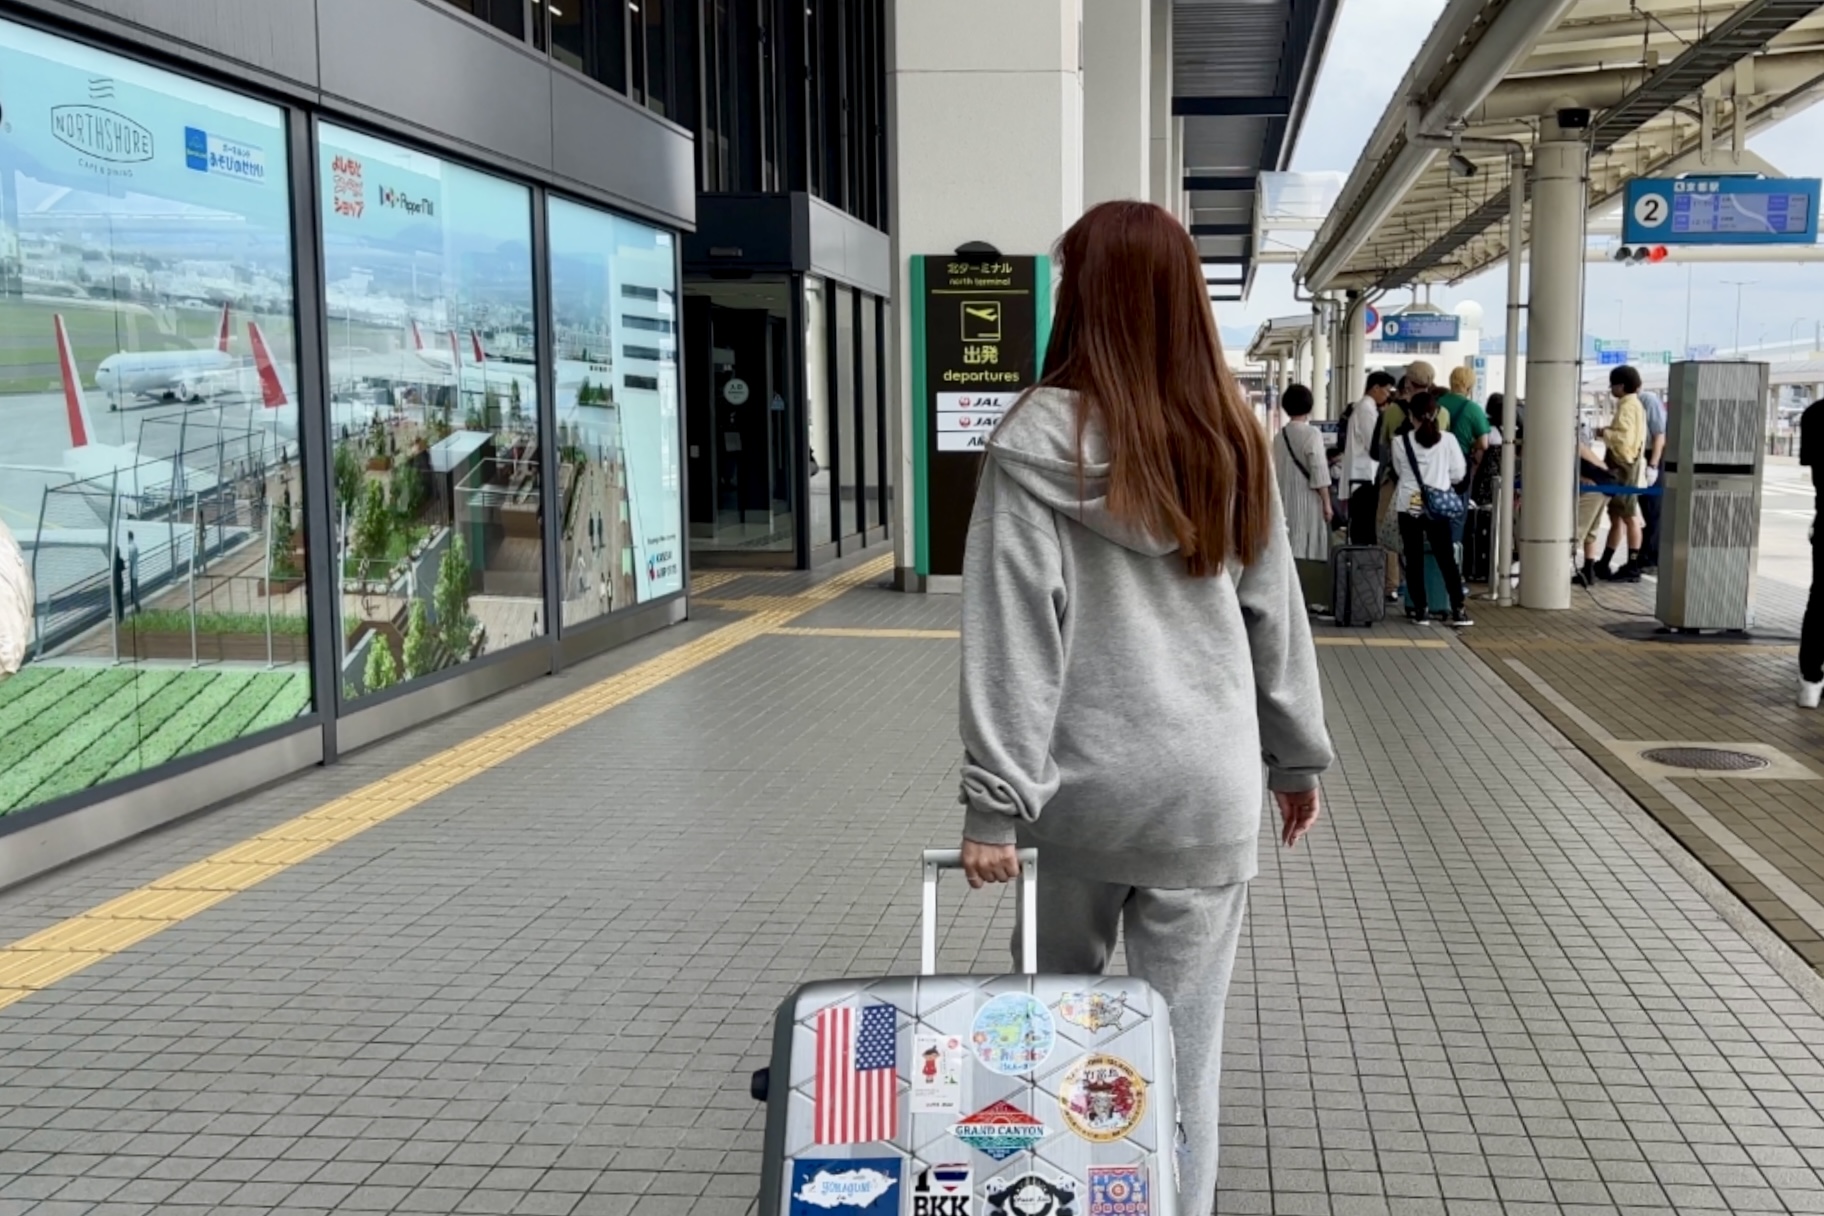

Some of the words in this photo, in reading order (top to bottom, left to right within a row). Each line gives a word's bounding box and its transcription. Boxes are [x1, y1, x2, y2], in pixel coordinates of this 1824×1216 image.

[55, 113, 149, 155] NORTHSHORE
[331, 154, 362, 178] よしもと
[1643, 198, 1659, 222] 2
[947, 261, 1013, 275] 北ターミナル
[949, 277, 974, 286] north
[974, 276, 1011, 287] terminal
[963, 345, 999, 365] 出発
[943, 369, 1020, 384] departures
[973, 398, 1003, 408] JAL
[955, 1126, 996, 1136] GRAND
[997, 1126, 1044, 1136] CANYON
[914, 1195, 969, 1216] BKK
